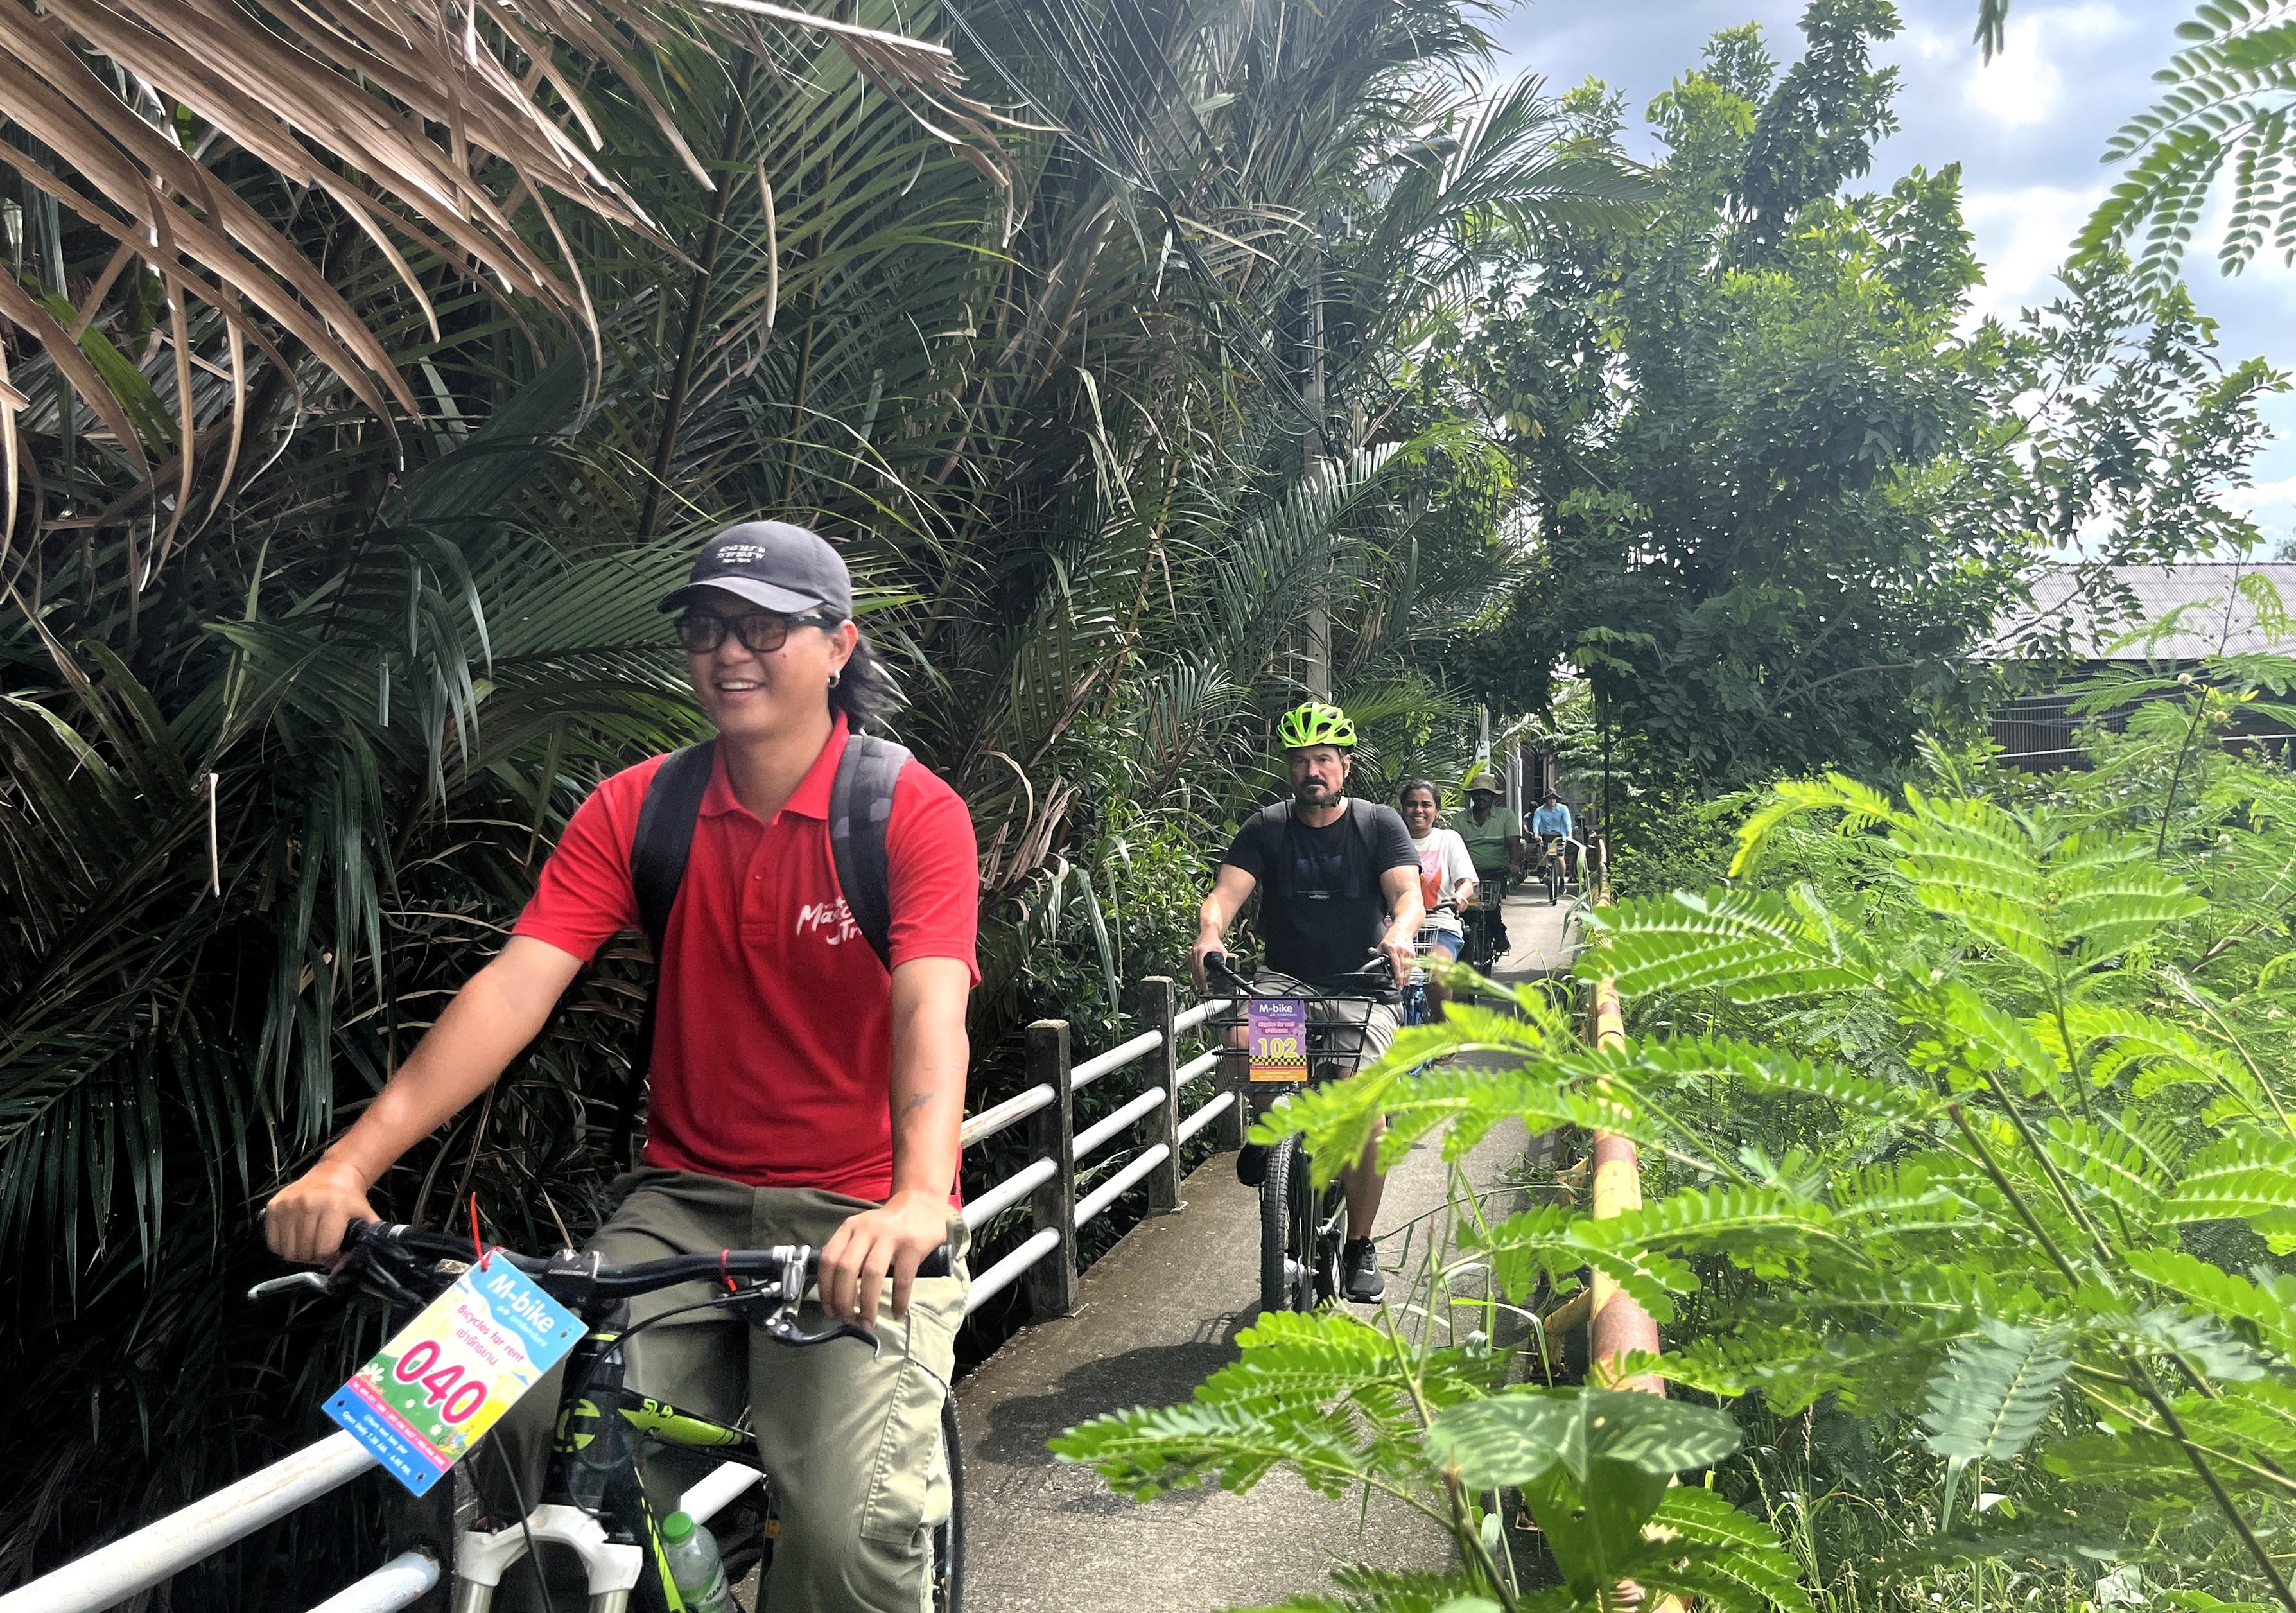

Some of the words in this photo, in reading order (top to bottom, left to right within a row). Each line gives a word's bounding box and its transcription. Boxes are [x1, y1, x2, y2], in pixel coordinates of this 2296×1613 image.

[1259, 1004, 1293, 1013] M-bike
[1258, 1038, 1298, 1058] 102
[487, 1273, 555, 1334] M-bike
[457, 1304, 492, 1334] Bicycles
[489, 1331, 506, 1347] for
[503, 1344, 525, 1363] rent
[396, 1340, 487, 1424] 040
[342, 1410, 357, 1424] Open
[354, 1422, 369, 1436] Daily
